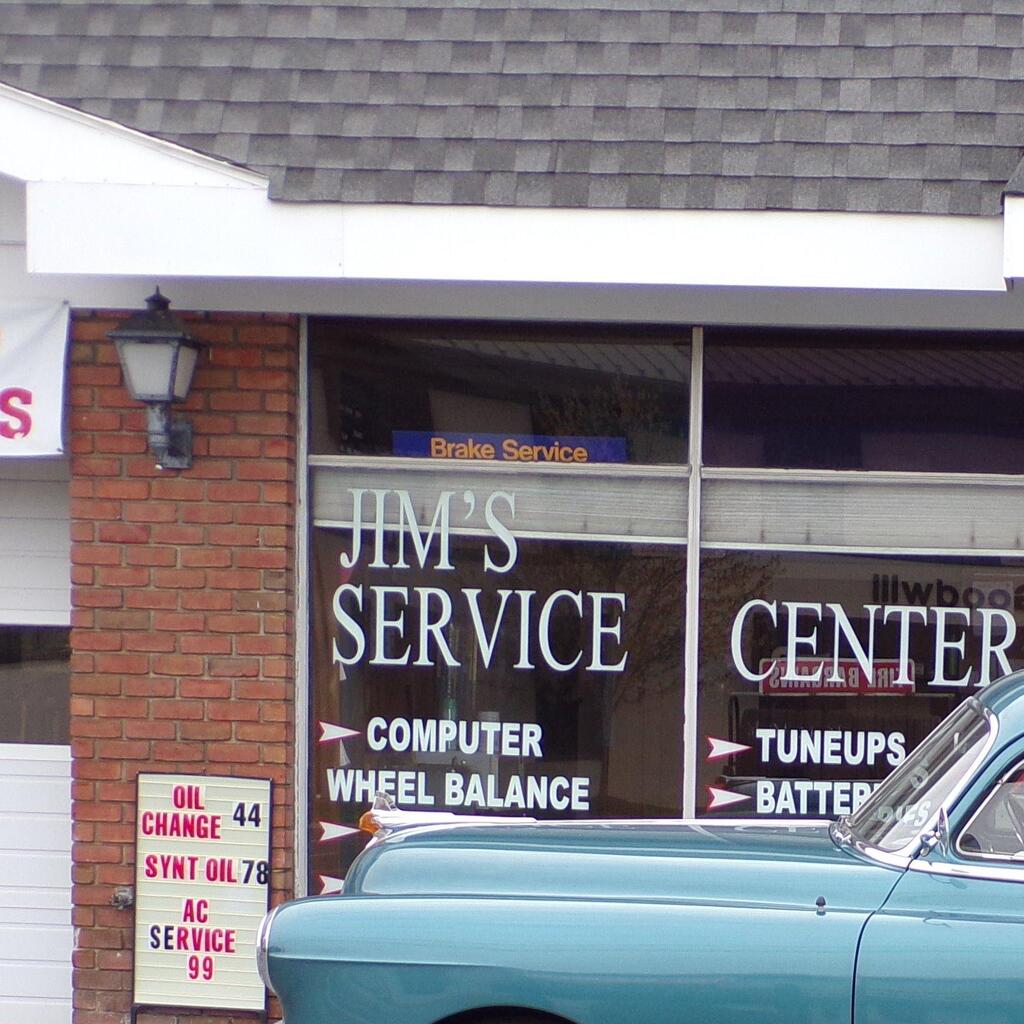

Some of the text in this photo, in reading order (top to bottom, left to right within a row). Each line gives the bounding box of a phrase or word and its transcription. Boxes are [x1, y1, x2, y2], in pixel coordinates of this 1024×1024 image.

[430, 438, 588, 463] Brake Service
[340, 488, 518, 573] JIM'S
[332, 583, 1017, 688] SERVICE CENTER
[367, 716, 543, 758] COMPUTER
[755, 729, 906, 766] TUNEUPS
[173, 785, 205, 810] OIL
[326, 768, 590, 811] WHEEL BALANCE
[142, 811, 221, 839] CHANGE
[233, 802, 261, 827] 44
[145, 854, 269, 885] SYNT OIL 78
[183, 898, 209, 923] AC
[150, 925, 235, 953] SERVICE
[188, 955, 213, 980] 99
